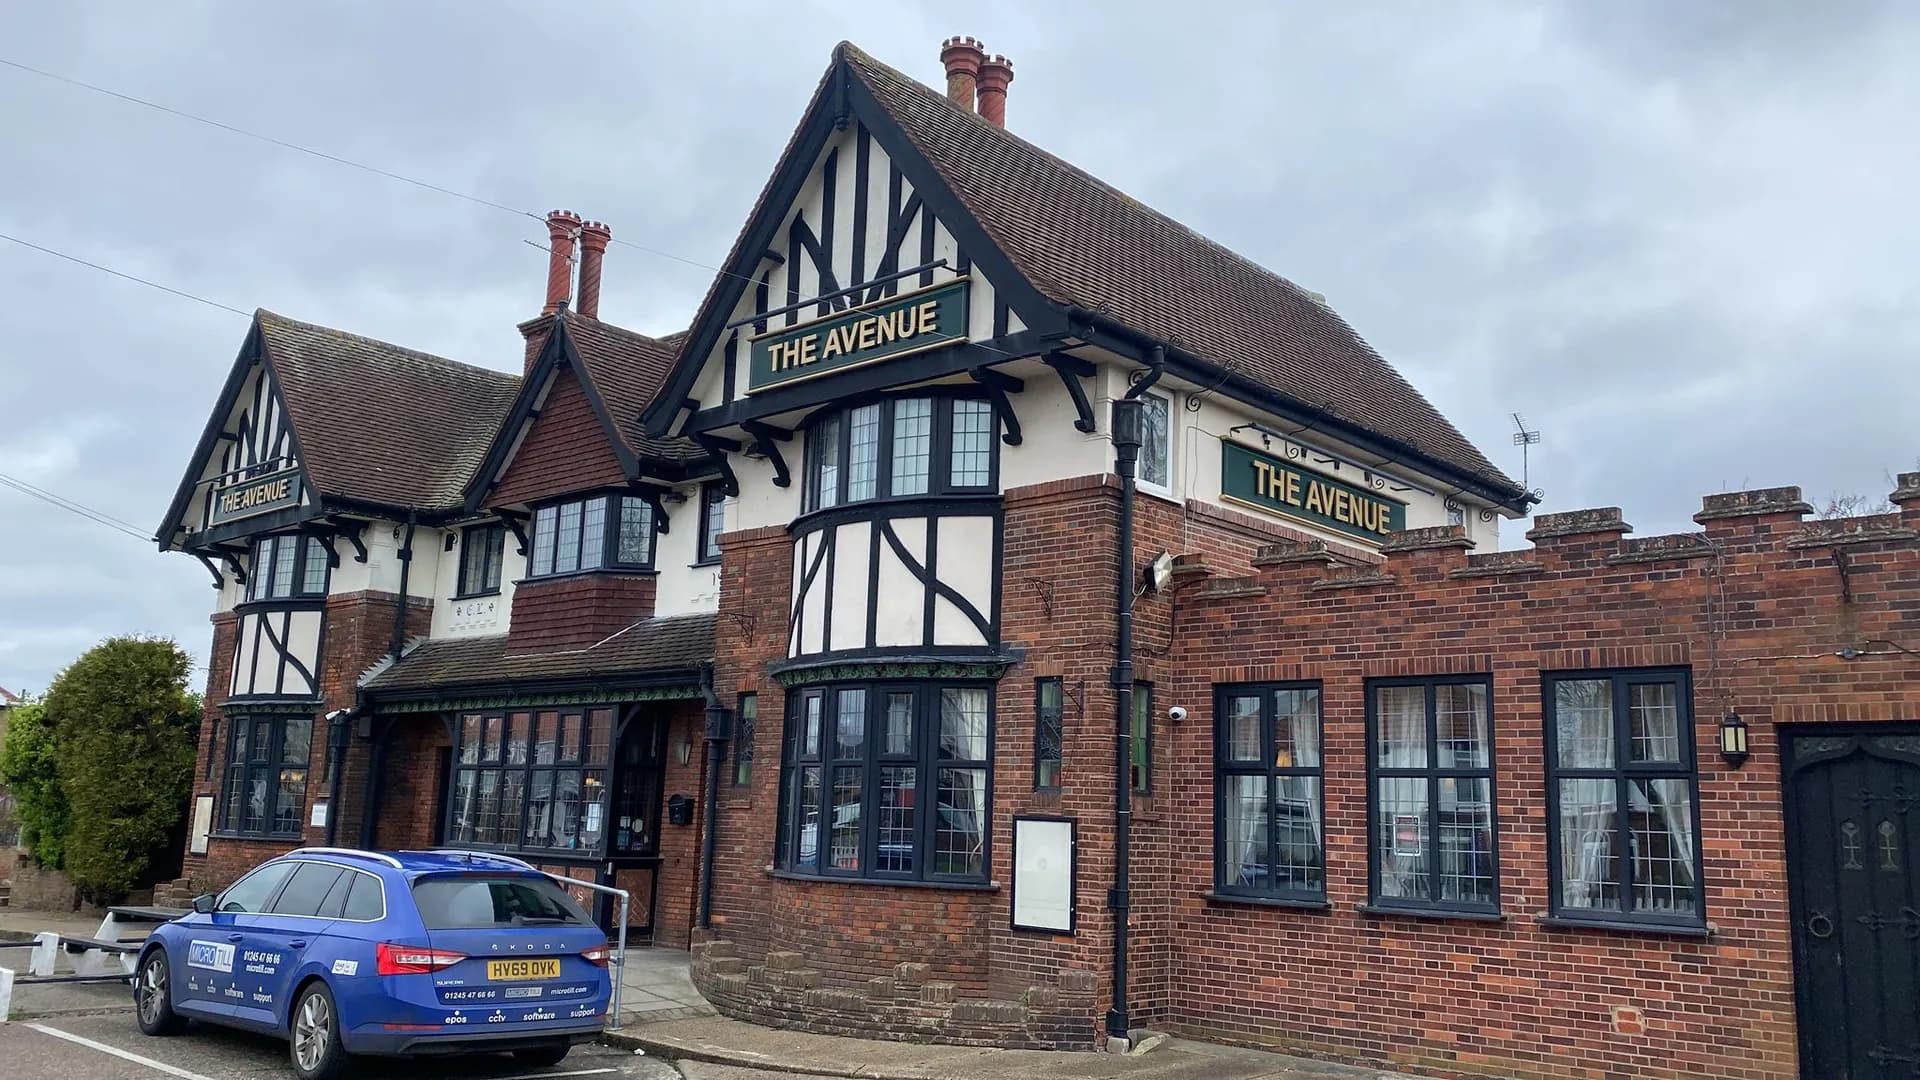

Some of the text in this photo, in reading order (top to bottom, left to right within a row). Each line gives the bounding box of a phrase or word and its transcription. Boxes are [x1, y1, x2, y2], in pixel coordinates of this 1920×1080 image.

[767, 300, 937, 372] THE AVENUE
[220, 478, 289, 513] THE AVENUE
[1253, 459, 1392, 535] THE AVENUE
[190, 944, 232, 967] MICRO TILL
[244, 950, 281, 965] 01245 47 66 66
[246, 963, 275, 975] microtill.com
[493, 961, 555, 977] HV69 OVK
[224, 988, 245, 999] software
[467, 991, 477, 999] 47
[487, 990, 496, 998] 66
[550, 986, 587, 995] microtill.com
[253, 993, 273, 1004] support
[523, 1011, 556, 1021] software
[570, 1007, 595, 1018] support
[445, 1016, 467, 1025] epos
[488, 1014, 506, 1023] cctv
